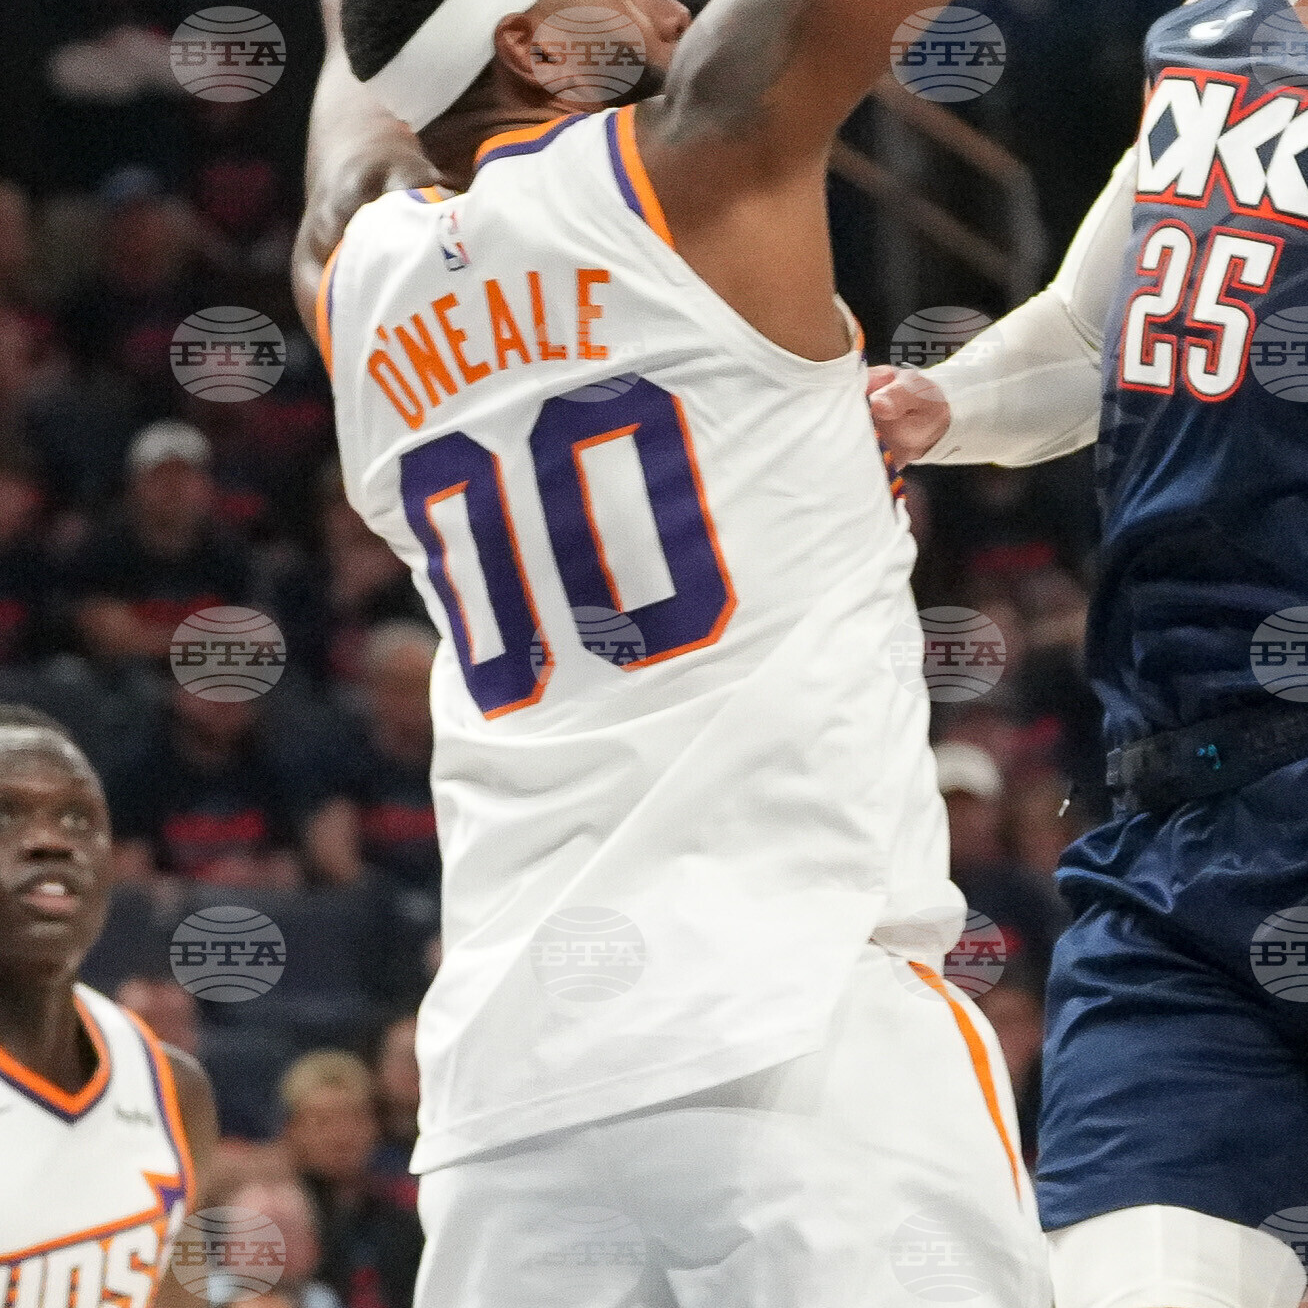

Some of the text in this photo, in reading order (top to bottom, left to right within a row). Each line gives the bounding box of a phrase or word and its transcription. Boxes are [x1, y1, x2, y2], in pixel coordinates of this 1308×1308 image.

[367, 268, 610, 431] O'NEALE
[1119, 220, 1286, 402] 25
[399, 371, 740, 721] 00
